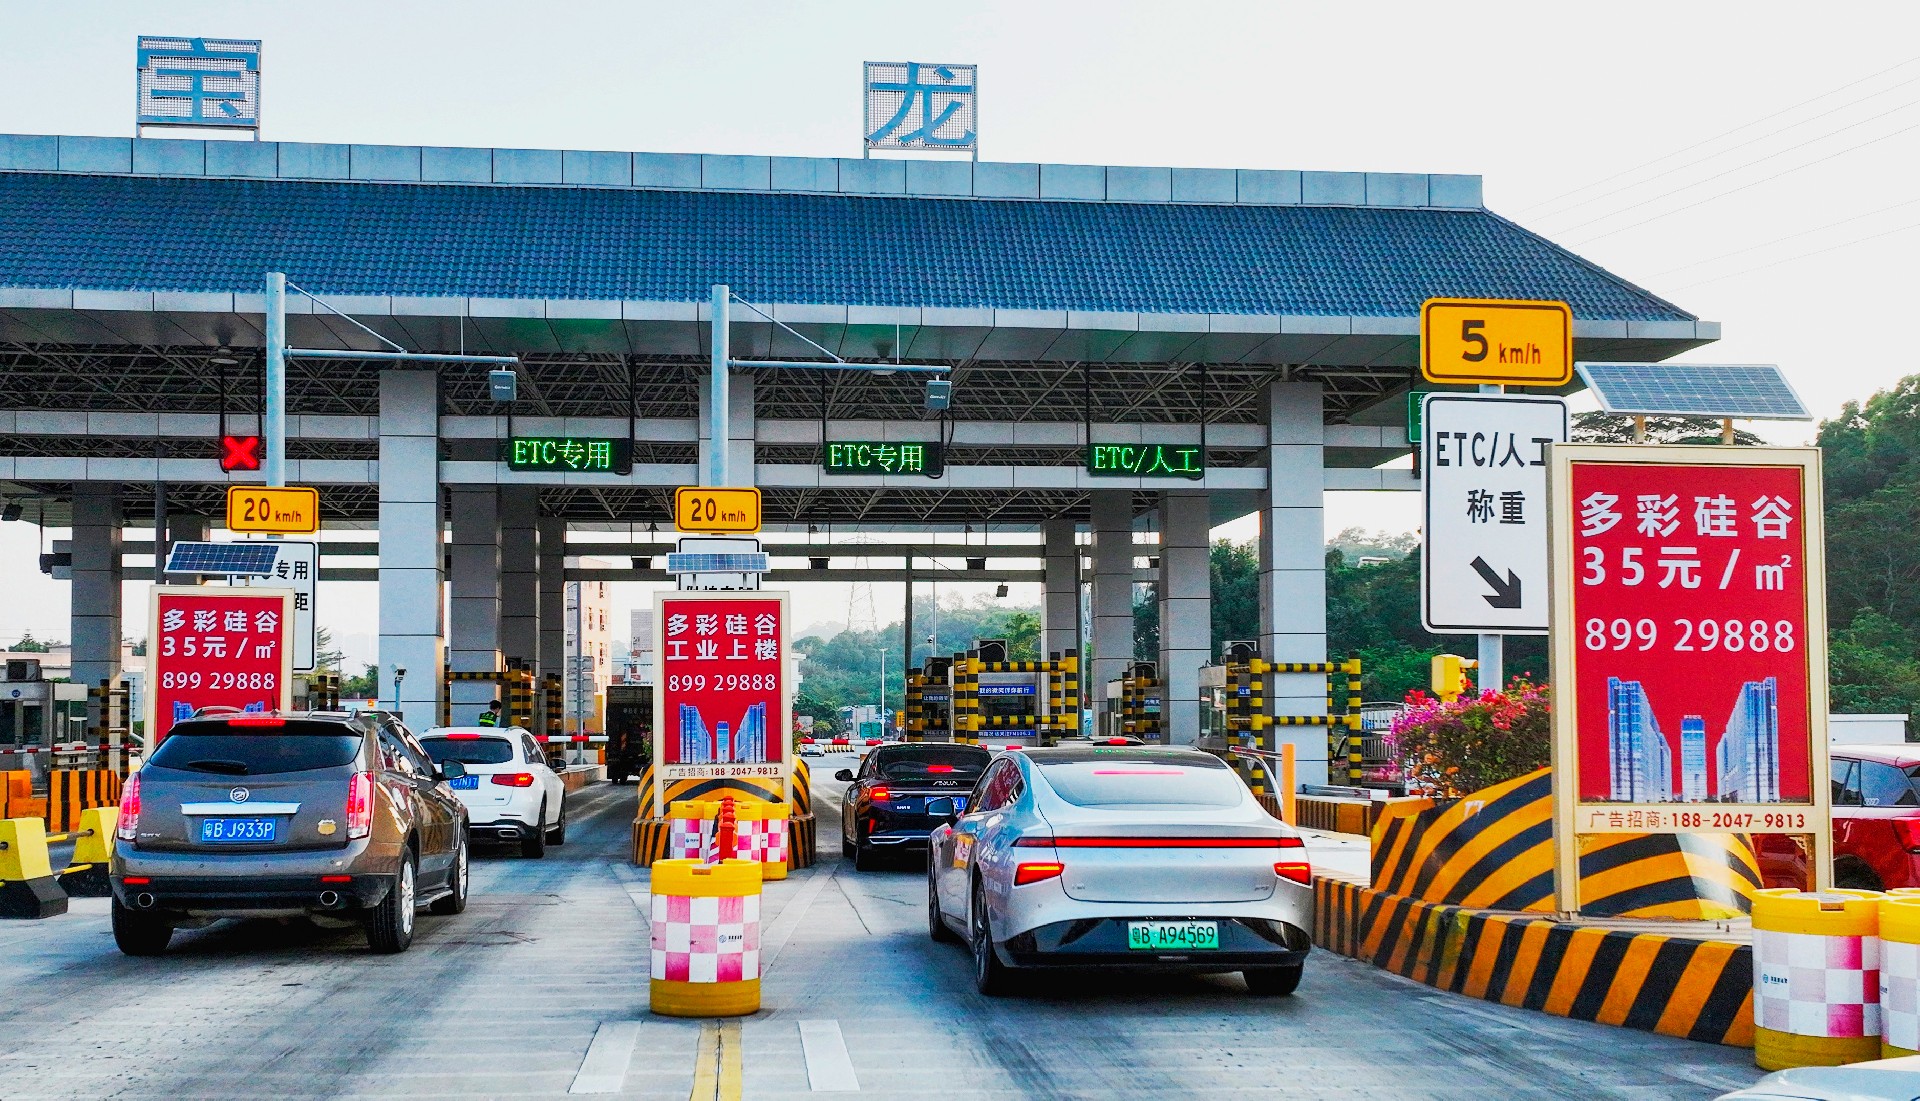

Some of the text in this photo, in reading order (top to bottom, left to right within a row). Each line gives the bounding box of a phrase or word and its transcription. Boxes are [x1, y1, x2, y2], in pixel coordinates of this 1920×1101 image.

[138, 37, 977, 146] 宝 龙
[1461, 319, 1541, 365] 5 km/h
[514, 439, 610, 469] ETC专用
[829, 443, 923, 473] ETC专用
[1094, 445, 1202, 473] ETC/人工
[1437, 432, 1553, 468] ETC/人工
[243, 497, 302, 522] 20 km/h
[690, 497, 746, 523] 20 km/h
[1467, 489, 1525, 525] 称重
[1580, 492, 1793, 540] 多彩硅谷
[162, 609, 278, 634] 多彩硅谷
[667, 612, 777, 637] 多彩硅谷
[1585, 617, 1795, 653] 899 29888
[666, 639, 778, 662] 工业上楼
[162, 671, 275, 690] 899 29888
[668, 673, 776, 692] 899 29888
